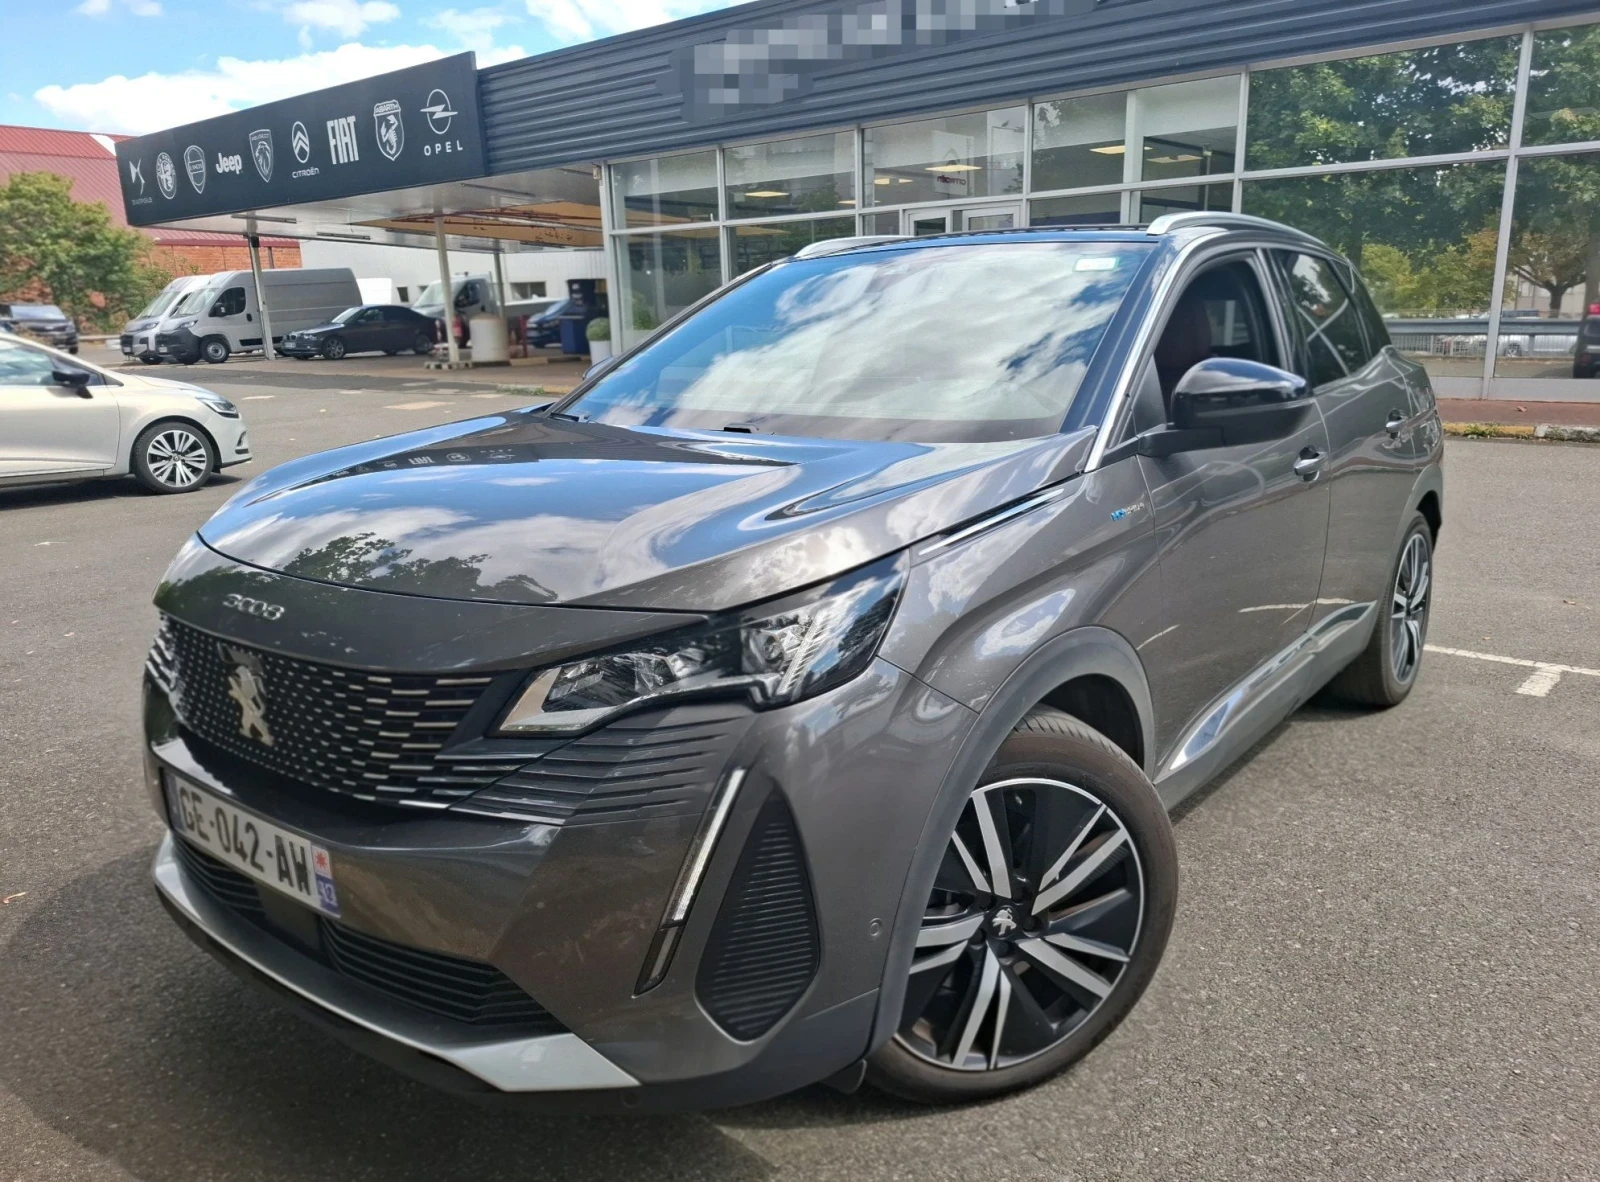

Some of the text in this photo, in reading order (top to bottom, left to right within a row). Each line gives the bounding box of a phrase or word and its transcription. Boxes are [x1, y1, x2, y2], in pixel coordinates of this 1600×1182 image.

[375, 103, 398, 112] ABARTH
[326, 115, 359, 165] FIAT
[423, 139, 464, 156] OPEL
[215, 152, 243, 175] Jeep
[222, 593, 285, 621] 3008
[179, 785, 312, 896] GE-042-AW
